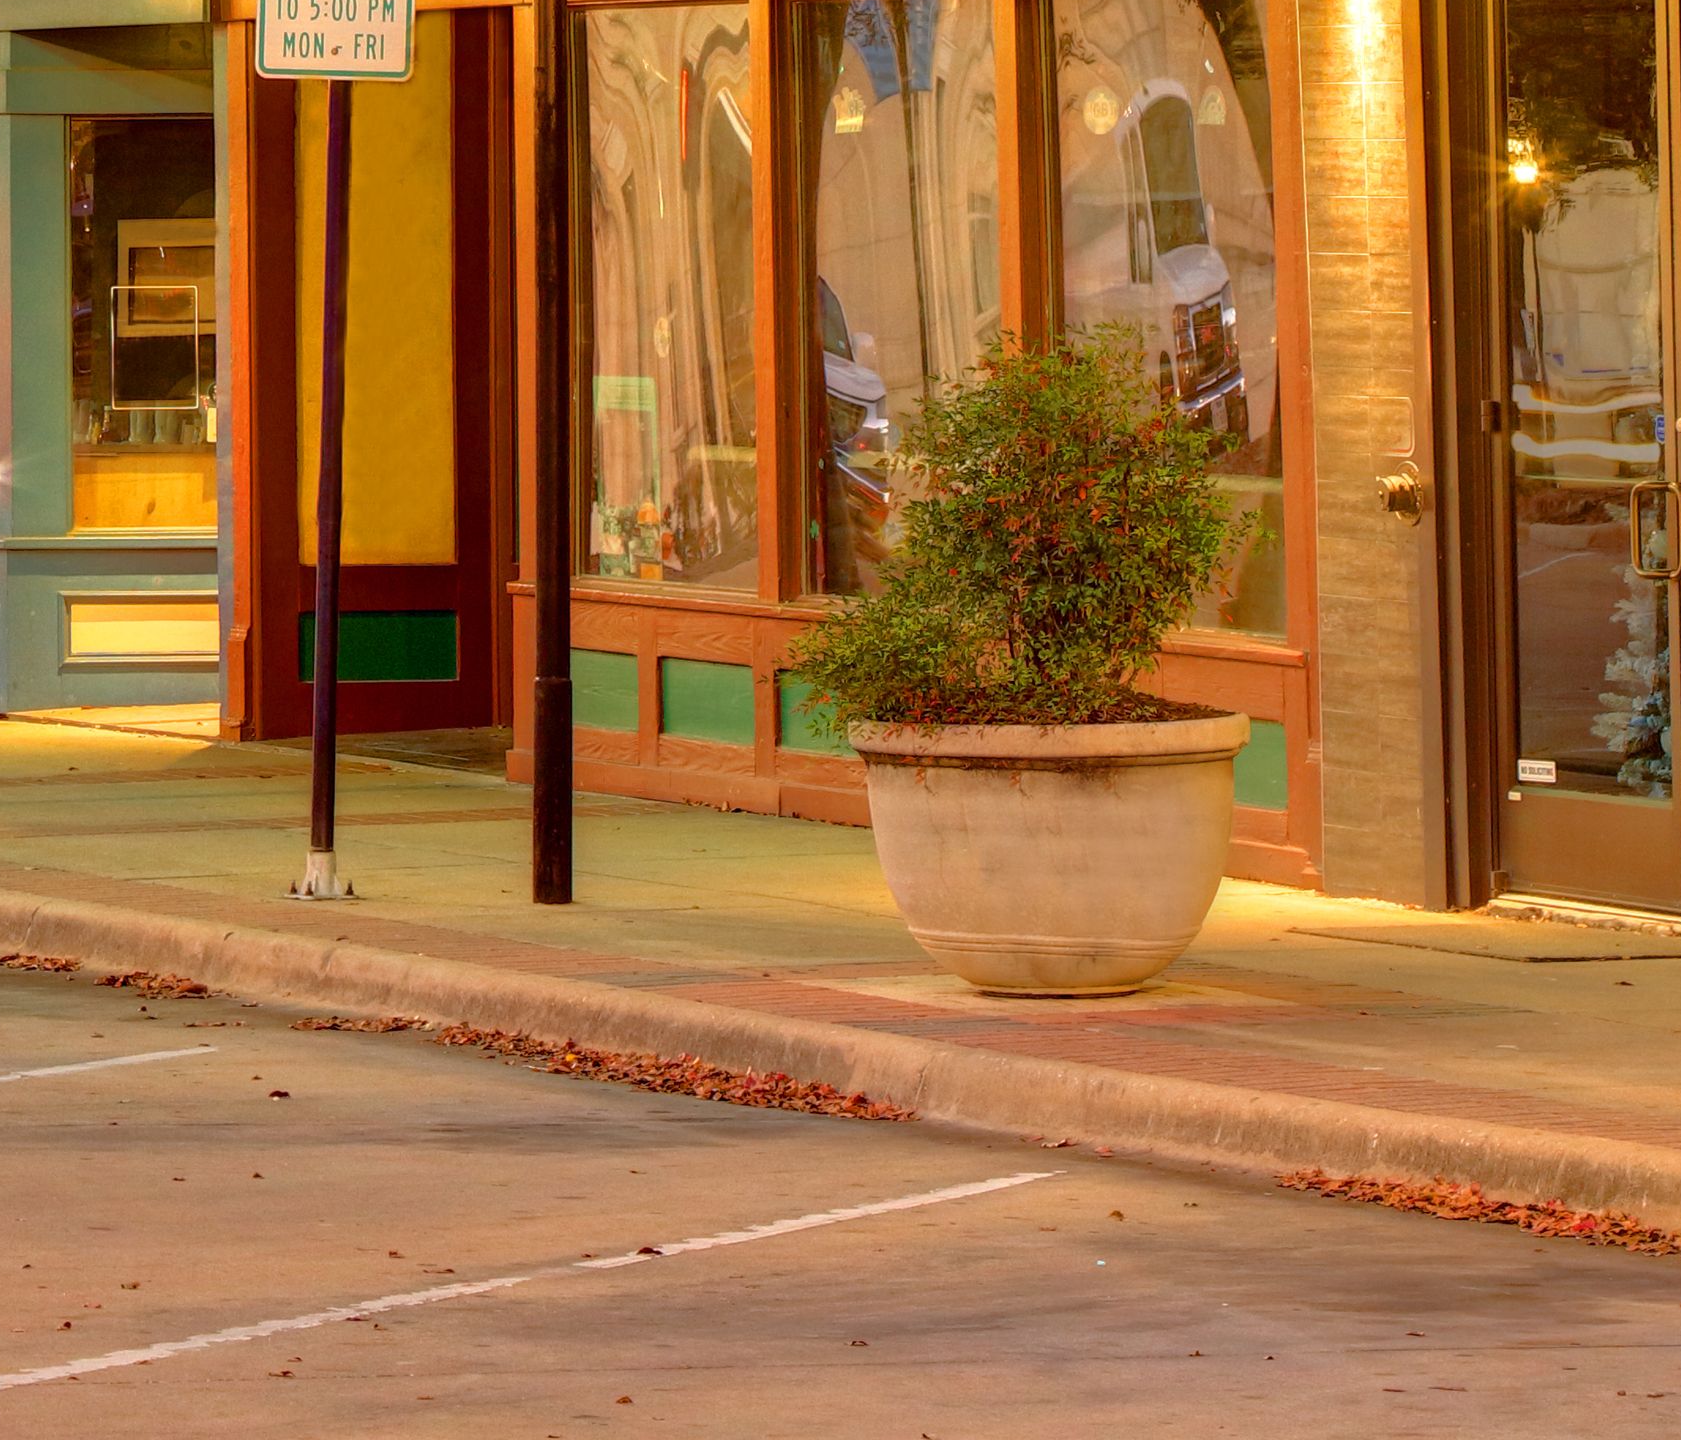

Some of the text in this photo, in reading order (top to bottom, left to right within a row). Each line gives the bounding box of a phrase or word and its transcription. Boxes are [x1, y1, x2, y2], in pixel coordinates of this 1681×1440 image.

[283, 32, 325, 58] MON
[354, 34, 385, 60] FRI
[1521, 766, 1527, 774] NO
